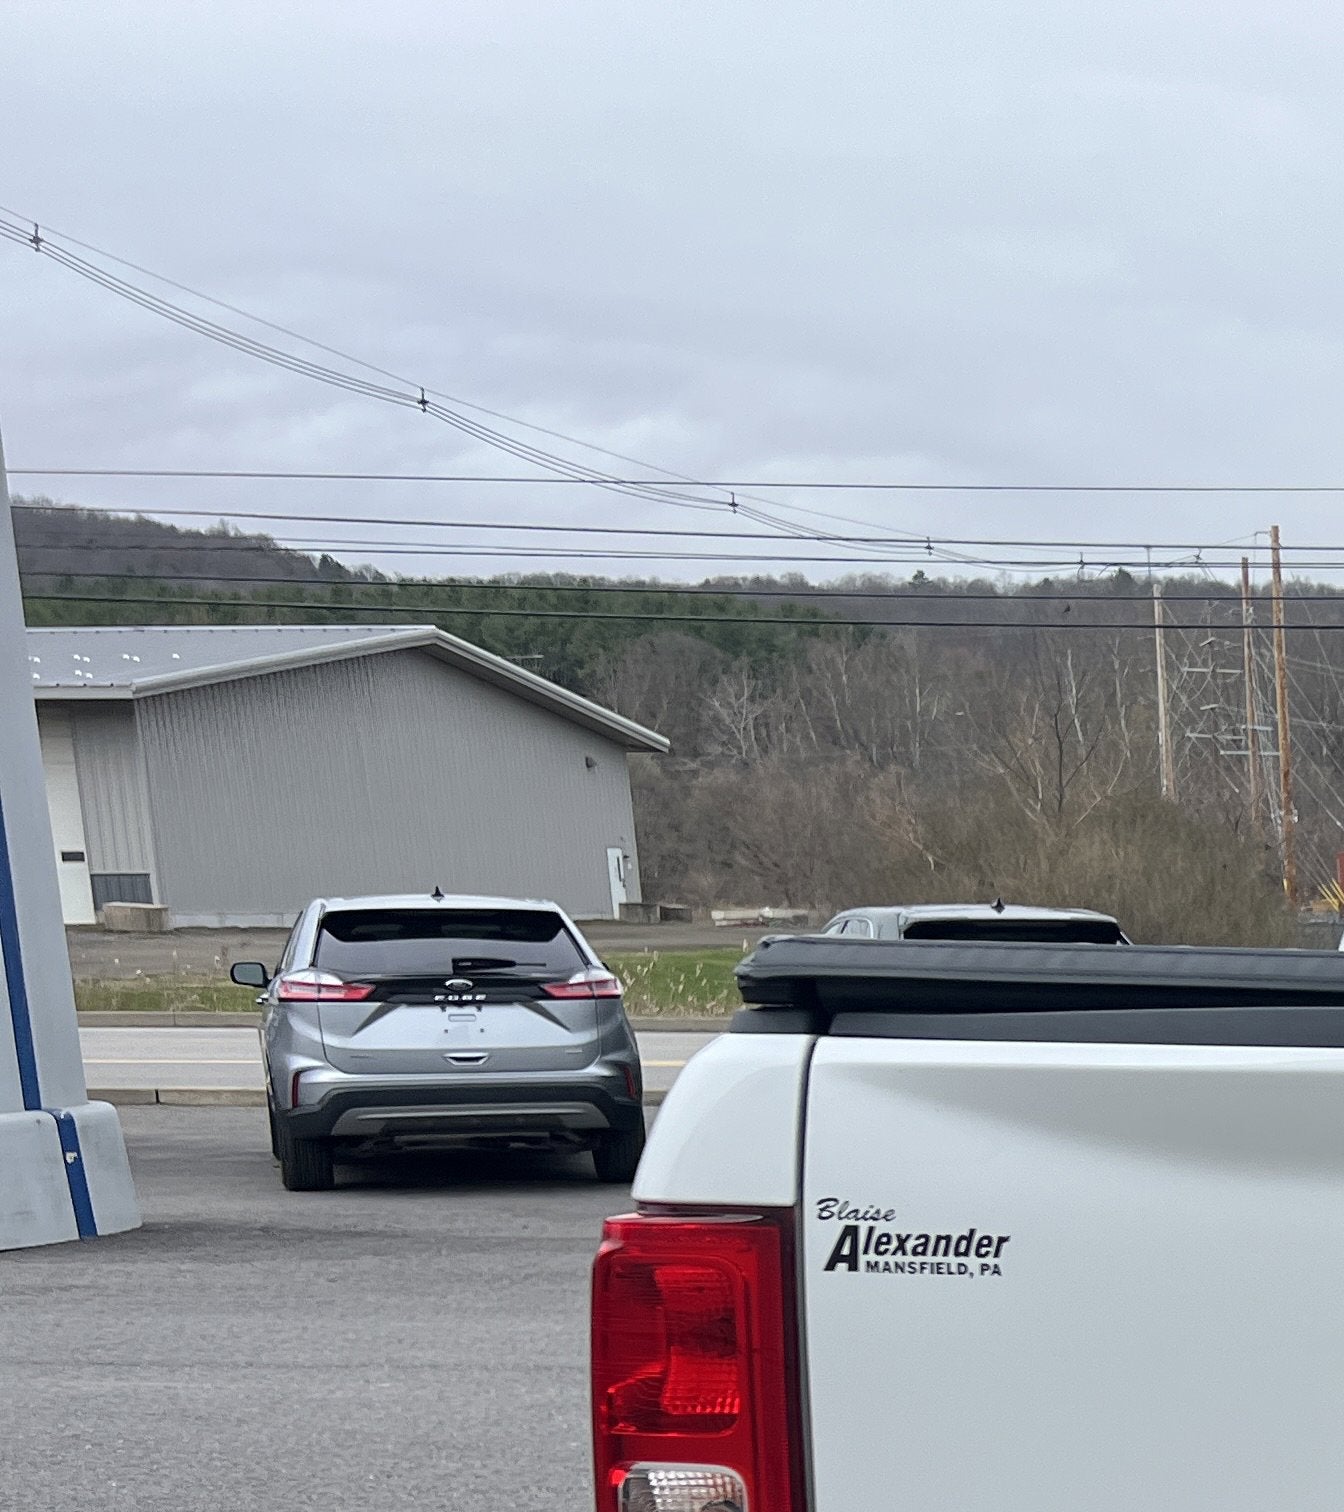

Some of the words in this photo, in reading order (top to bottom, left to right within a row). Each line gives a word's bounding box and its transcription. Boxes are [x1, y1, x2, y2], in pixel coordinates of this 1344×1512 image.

[816, 1197, 897, 1222] Blaise
[823, 1224, 1011, 1272] Alexander
[865, 1260, 975, 1278] MANSFIELD,
[980, 1263, 1002, 1276] PA
